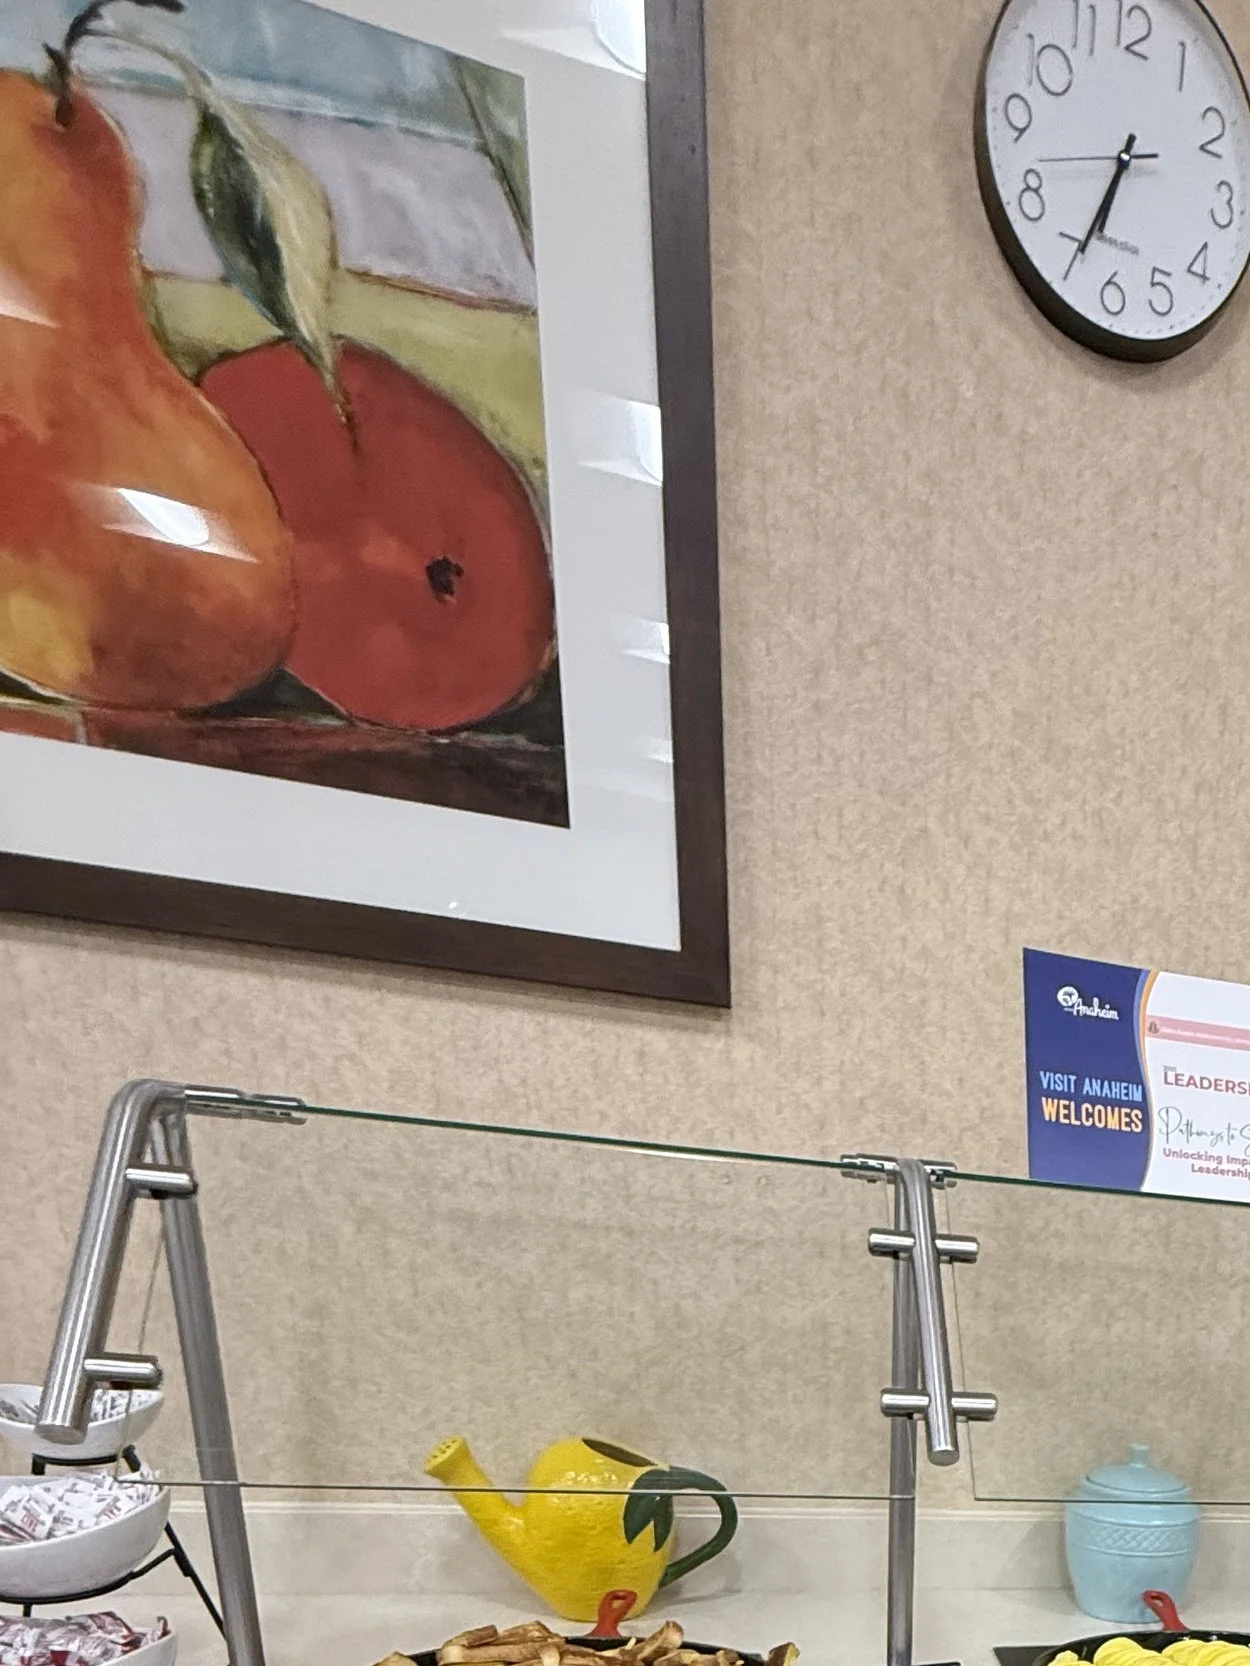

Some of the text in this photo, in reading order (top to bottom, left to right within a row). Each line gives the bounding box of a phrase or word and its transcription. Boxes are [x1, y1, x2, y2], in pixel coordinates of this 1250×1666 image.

[1072, 0, 1096, 56] 11
[1116, 0, 1152, 61] 12
[1027, 33, 1073, 96] 10
[1177, 41, 1187, 92] 1
[1004, 93, 1032, 143] 9
[1199, 106, 1225, 160] 2
[1018, 168, 1045, 222] 8
[1210, 180, 1234, 229] 3
[1058, 231, 1082, 281] 7
[1186, 241, 1210, 283] 4
[1100, 271, 1126, 316] 6
[1148, 266, 1173, 316] 5
[1073, 996, 1119, 1020] Anaheim
[1040, 1071, 1142, 1102] VISIT ANAHEIM
[1041, 1097, 1143, 1133] WELCOMES
[1163, 1147, 1223, 1165] Unlocking
